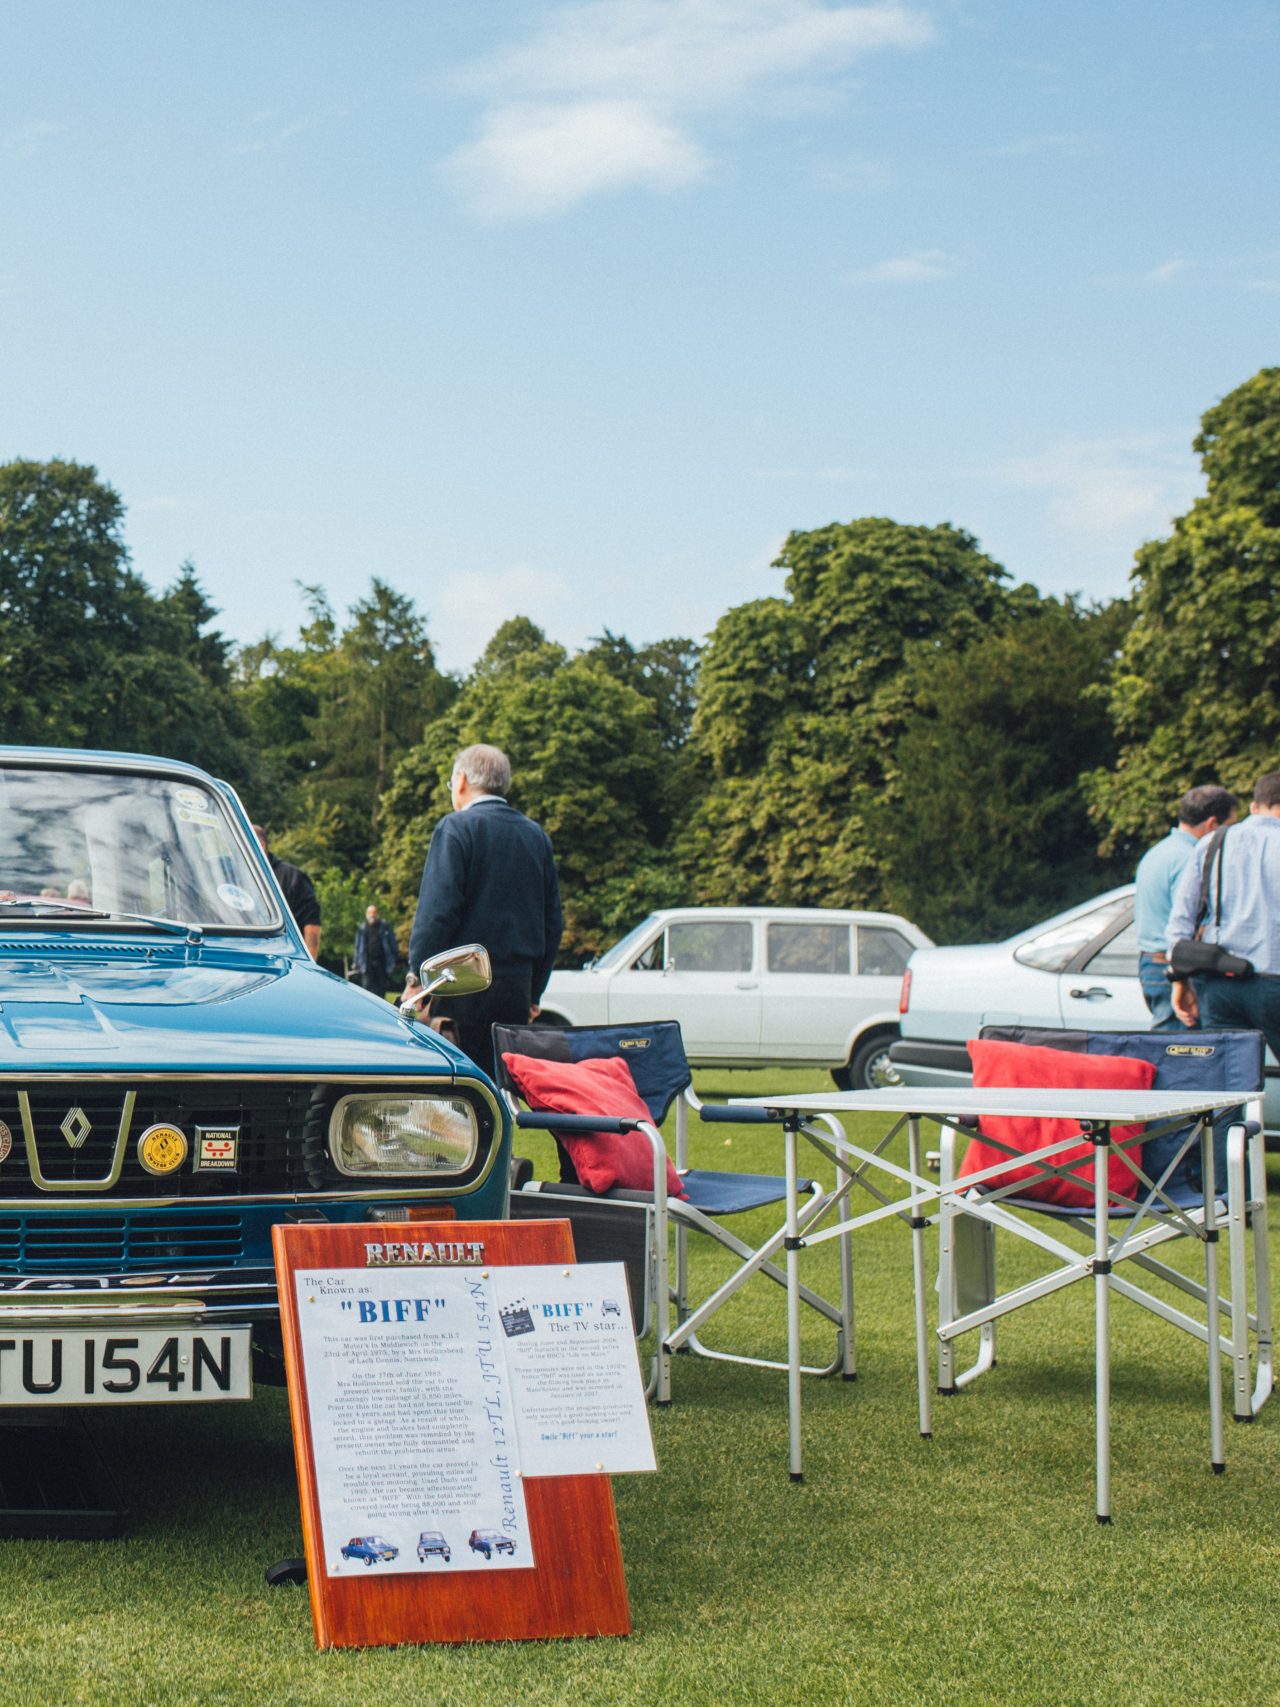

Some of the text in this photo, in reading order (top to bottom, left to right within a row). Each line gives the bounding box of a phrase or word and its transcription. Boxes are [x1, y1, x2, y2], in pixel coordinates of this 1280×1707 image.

[152, 1132, 178, 1141] RENAULT
[147, 1152, 180, 1168] OWNERS CLUB
[200, 1160, 235, 1168] BREAKDOWN
[364, 1242, 485, 1265] RENAULT
[304, 1277, 345, 1286] The Car
[319, 1286, 373, 1295] Known as:
[340, 1298, 446, 1323] "BIFF"
[532, 1302, 593, 1318] "BIFF"
[548, 1323, 570, 1332] The
[573, 1321, 589, 1332] TV
[83, 1336, 232, 1394] 154N
[464, 1276, 518, 1533] Renault 12TL, JTU 154N
